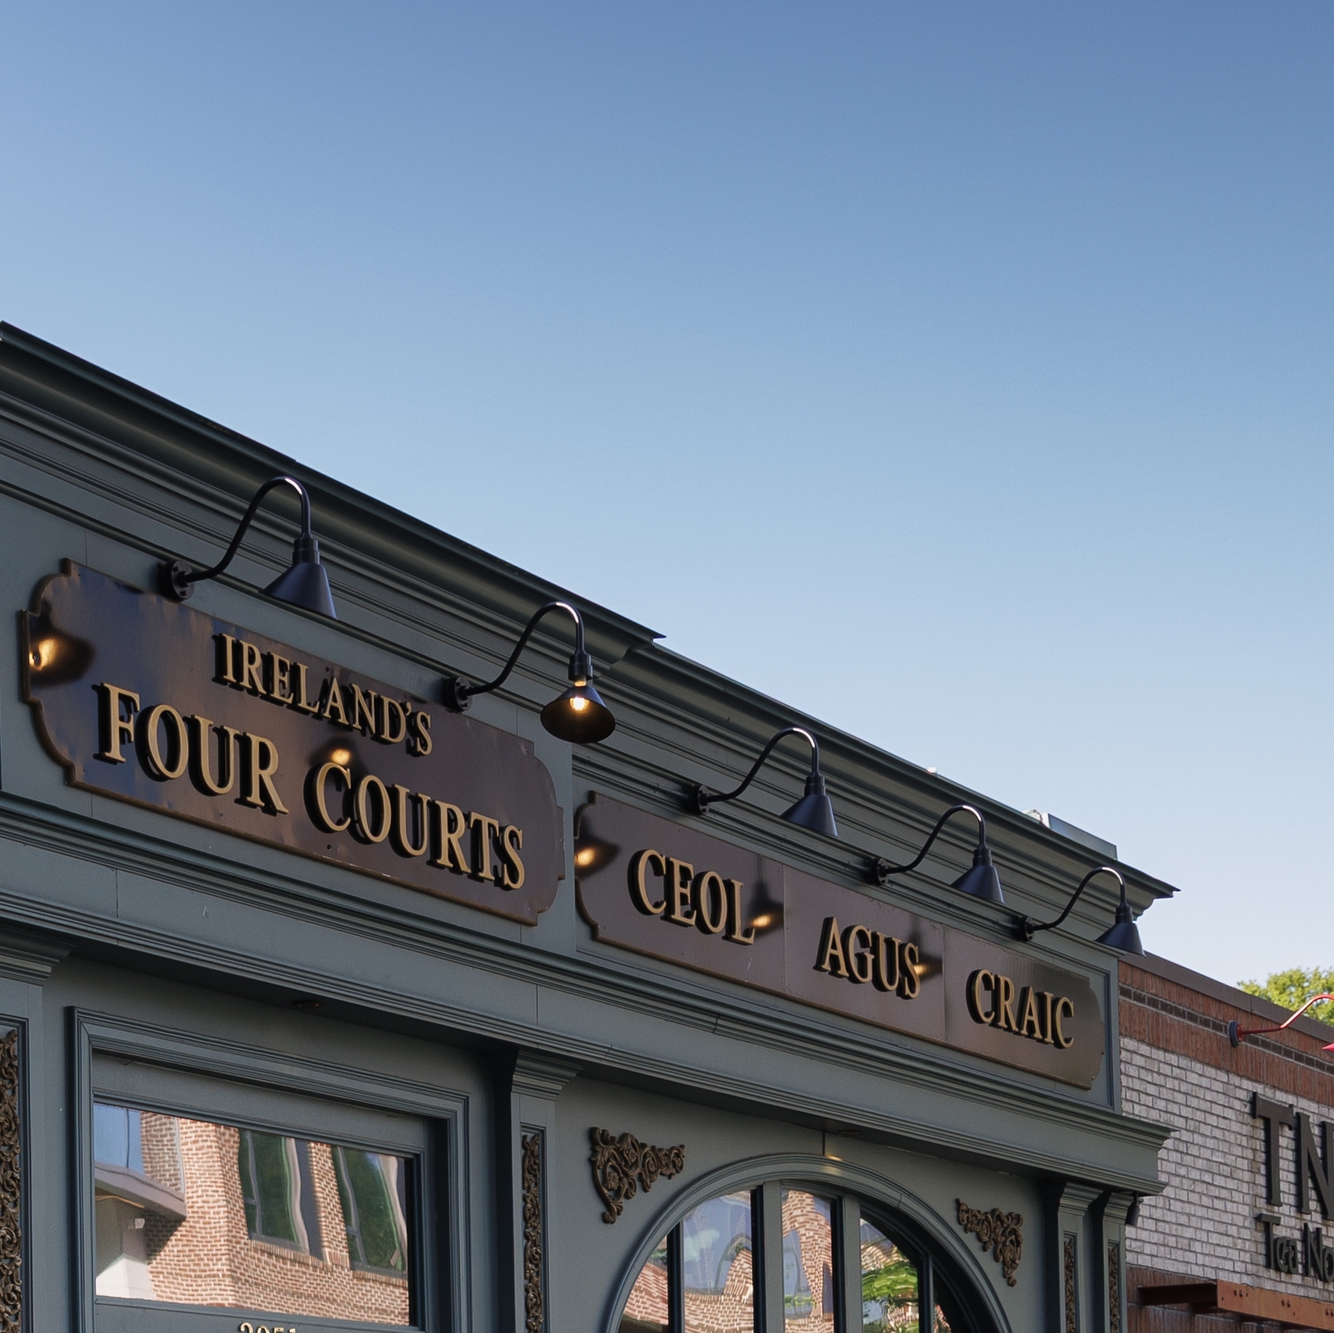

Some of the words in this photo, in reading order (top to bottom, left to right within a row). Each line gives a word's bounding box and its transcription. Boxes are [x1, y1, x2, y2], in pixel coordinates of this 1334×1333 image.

[214, 631, 433, 756] IRELAND'S
[95, 683, 288, 815] FOUR
[306, 760, 526, 891] COURTS
[629, 849, 756, 945] CEOL
[818, 915, 921, 998] AGUS
[968, 967, 1075, 1049] CRAIC
[1254, 1213, 1298, 1274] Tea
